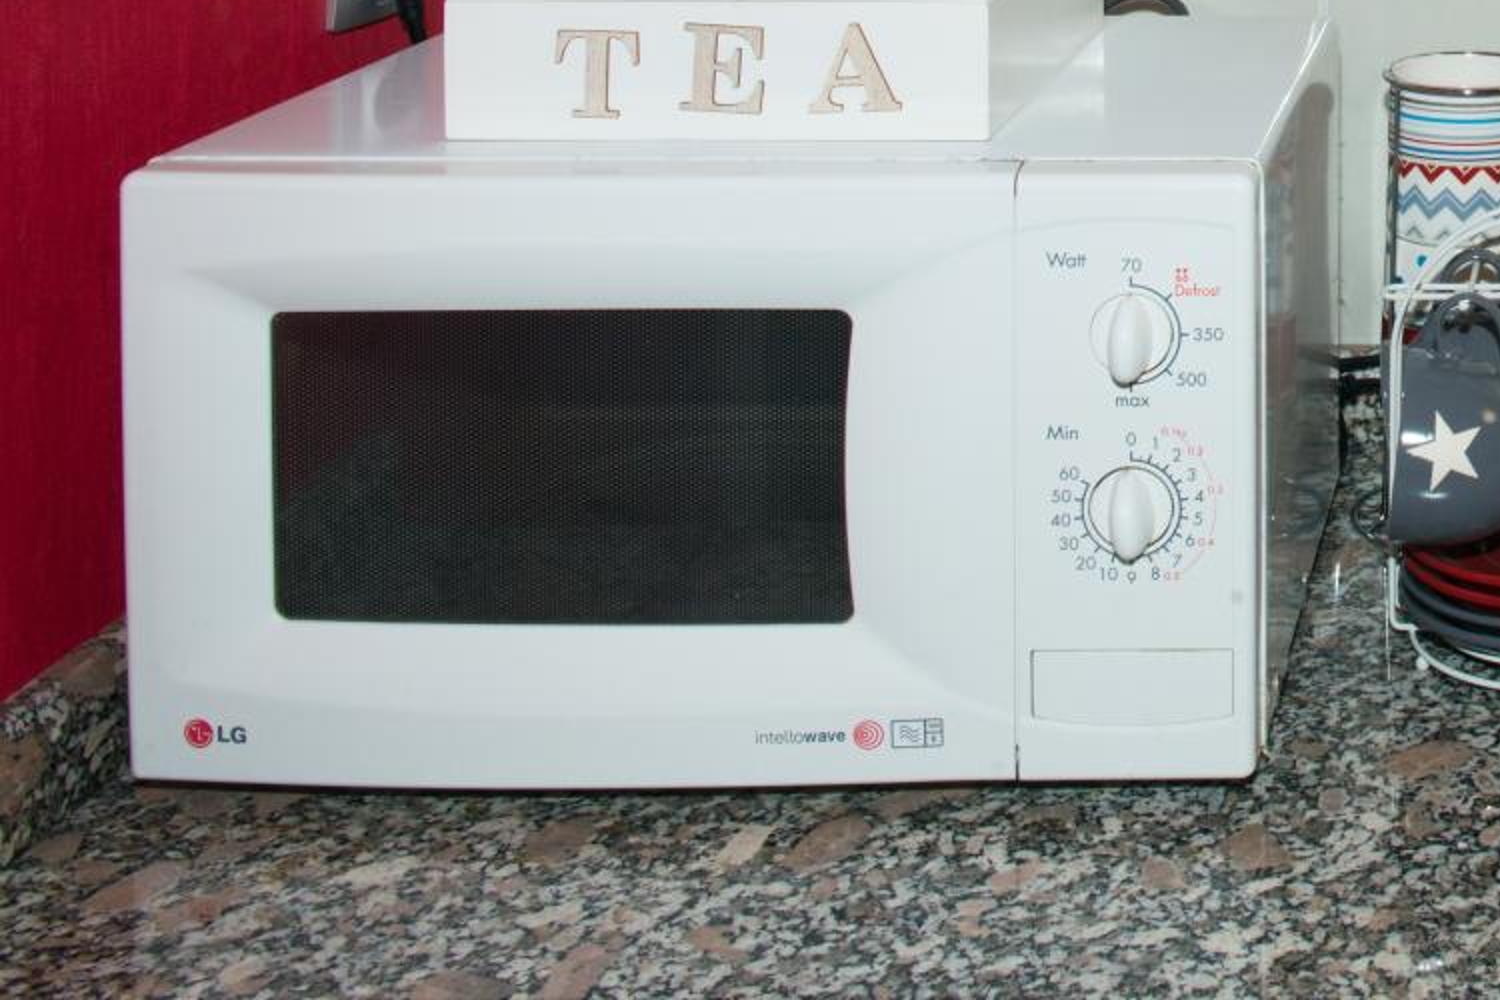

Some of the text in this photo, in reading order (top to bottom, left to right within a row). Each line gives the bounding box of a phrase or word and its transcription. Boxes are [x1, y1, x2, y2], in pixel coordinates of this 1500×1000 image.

[554, 20, 904, 120] TEA
[1046, 252, 1088, 269] Watt
[1121, 257, 1143, 274] 70
[1192, 327, 1225, 342] 350
[1177, 371, 1207, 388] 500
[1115, 395, 1150, 409] max
[1046, 425, 1080, 441] Min
[1125, 431, 1137, 447] 0
[1152, 435, 1159, 451] 1
[1171, 447, 1182, 463] 2
[1058, 466, 1080, 482] 60
[1186, 467, 1197, 482] 3
[1051, 489, 1072, 504] 50
[1194, 489, 1205, 504] 4
[1050, 512, 1071, 528] 40
[1193, 510, 1204, 526] 5
[1058, 536, 1080, 552] 30
[1185, 533, 1196, 548] 6
[1075, 555, 1097, 571] 20
[1172, 553, 1183, 569] 7
[1099, 566, 1119, 582] 10
[1150, 566, 1161, 582] 8
[216, 725, 248, 744] LG
